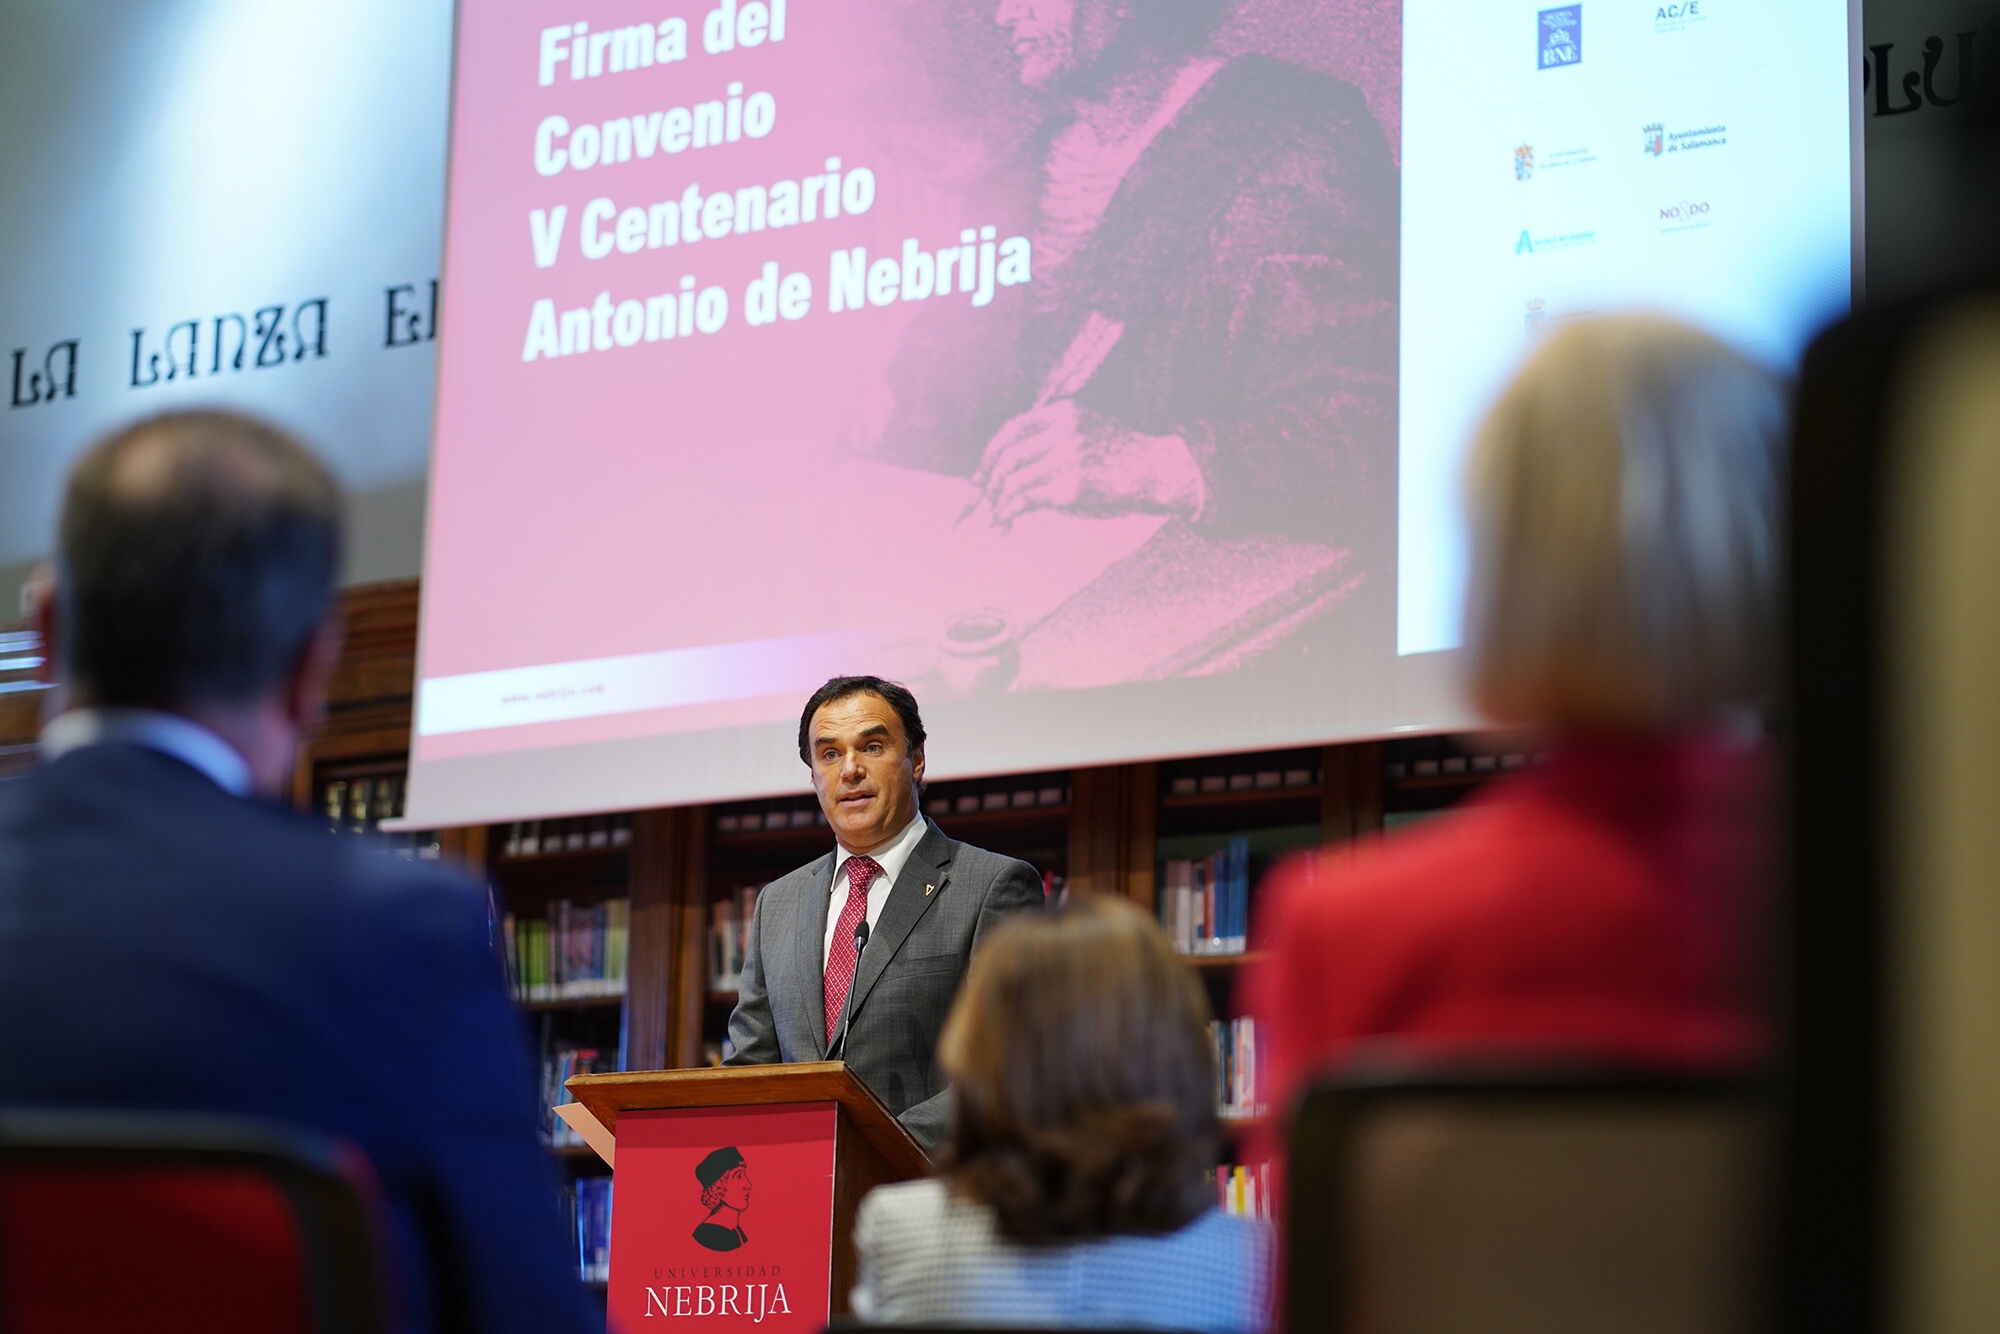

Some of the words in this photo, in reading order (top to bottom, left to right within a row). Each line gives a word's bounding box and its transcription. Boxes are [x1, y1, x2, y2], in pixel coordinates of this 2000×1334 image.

[538, 16, 687, 87] Firma
[703, 0, 787, 55] del
[534, 81, 776, 177] Convenio
[529, 205, 568, 269] V
[580, 156, 876, 260] Centenario
[522, 275, 729, 363] Antonio
[744, 261, 812, 328] de
[828, 225, 1032, 313] Nebrija
[11, 338, 80, 410] LA
[129, 296, 330, 389] LANZA
[644, 1283, 792, 1323] NEBRIJA
[654, 1265, 781, 1279] UNIVERSIDAD
